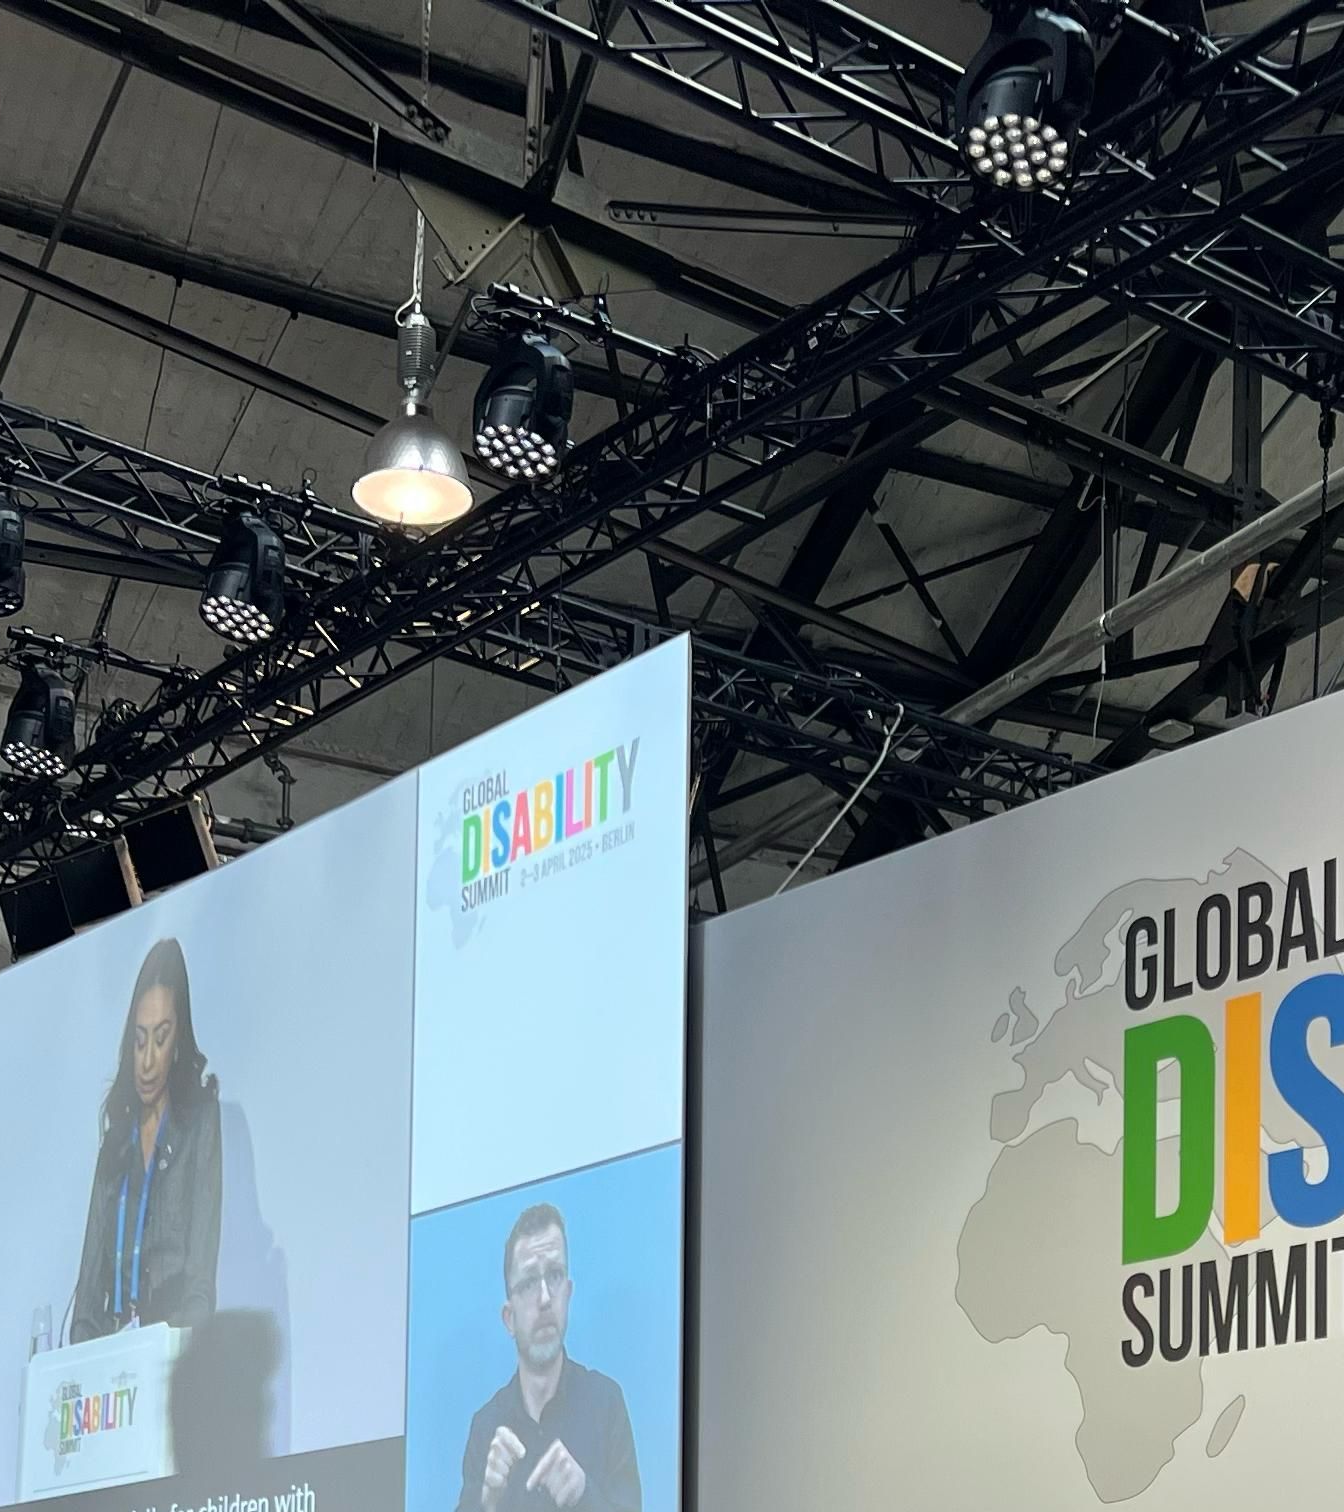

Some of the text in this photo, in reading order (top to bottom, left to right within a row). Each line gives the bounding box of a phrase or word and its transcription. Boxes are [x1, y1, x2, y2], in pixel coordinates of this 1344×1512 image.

[462, 737, 640, 884] DISABILITY
[463, 769, 509, 814] GLOBAL
[541, 851, 566, 878] APRIL
[569, 840, 593, 867] 2025
[601, 821, 635, 853] BERLIN
[461, 867, 511, 912] SUMMIT
[60, 1386, 137, 1440] DISABILITY
